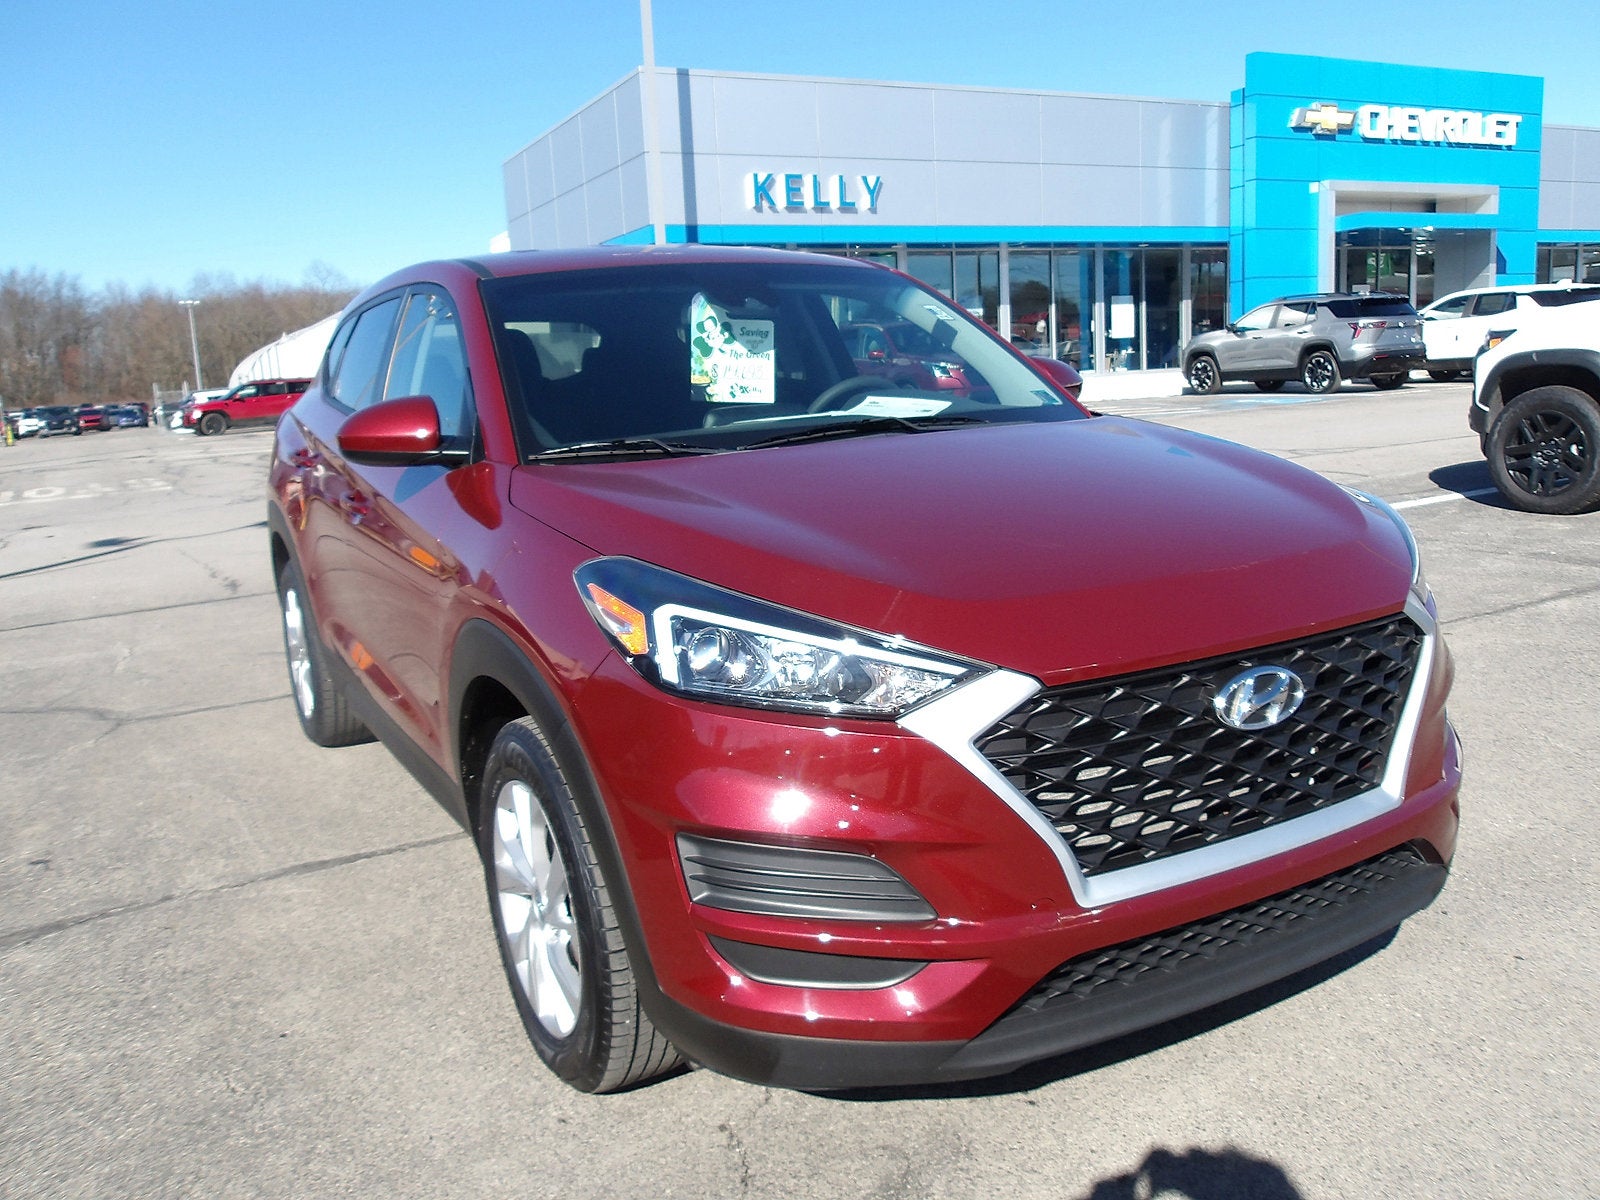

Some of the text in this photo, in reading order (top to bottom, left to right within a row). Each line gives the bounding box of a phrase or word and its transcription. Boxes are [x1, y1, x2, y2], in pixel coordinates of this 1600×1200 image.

[1358, 104, 1522, 146] CHEVROLET
[749, 172, 882, 210] KELLY
[740, 326, 769, 338] Saving
[729, 349, 771, 360] The Green
